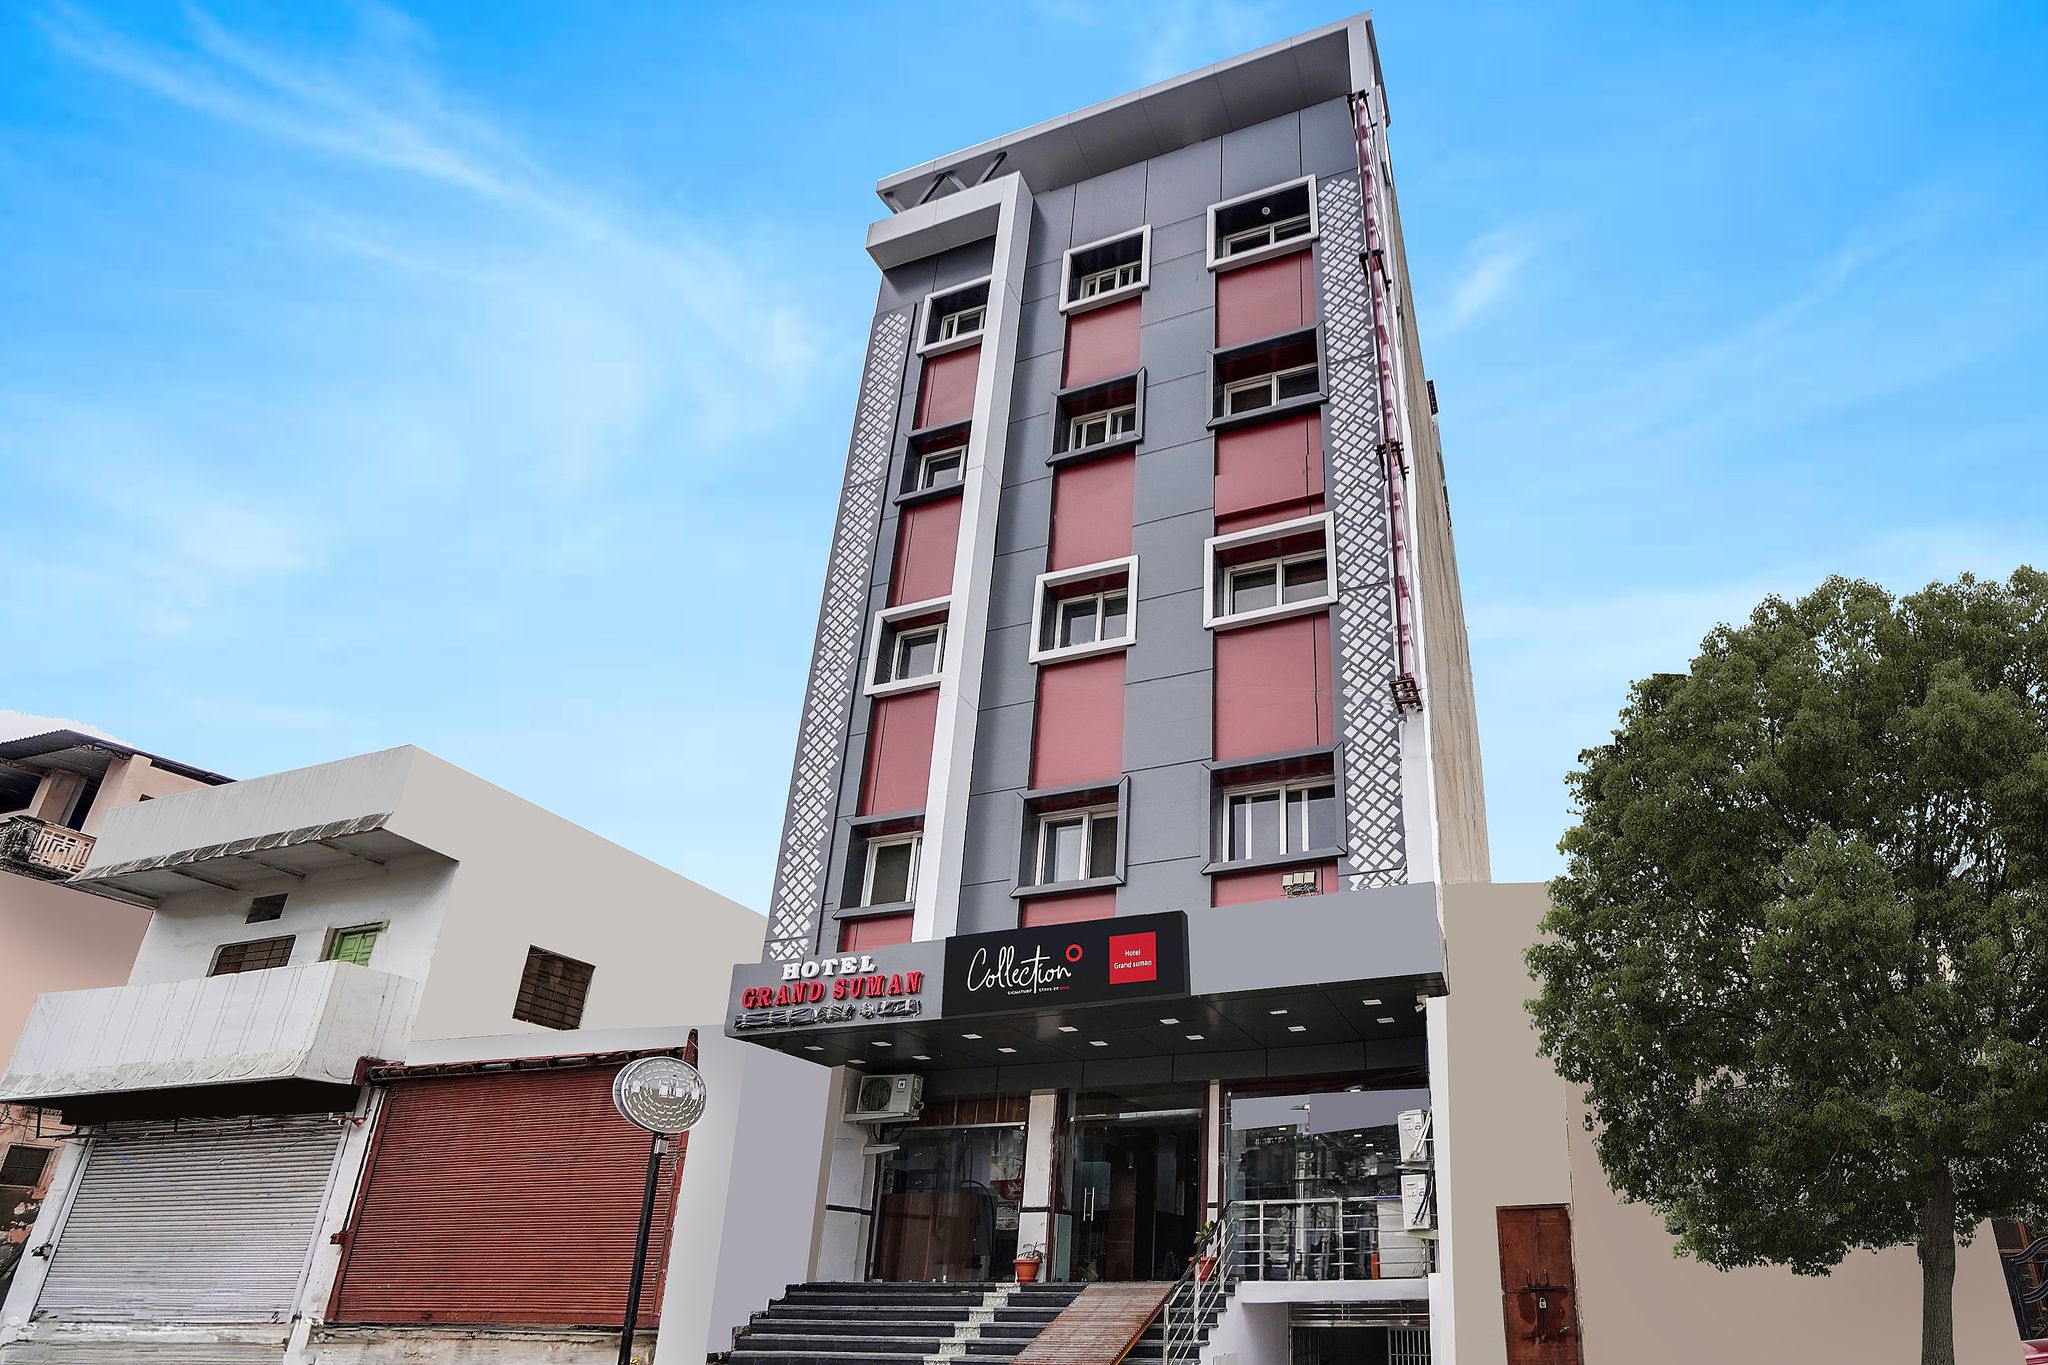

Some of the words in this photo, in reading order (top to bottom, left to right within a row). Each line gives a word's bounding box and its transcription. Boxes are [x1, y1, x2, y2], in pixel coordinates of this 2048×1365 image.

[1113, 961, 1132, 970] Grand
[1132, 960, 1153, 968] suman
[1124, 949, 1141, 957] Hotel
[781, 955, 876, 981] HOTEL
[967, 944, 1072, 994] Collection
[741, 980, 825, 1009] GRAND
[832, 971, 923, 1000] SUMAN
